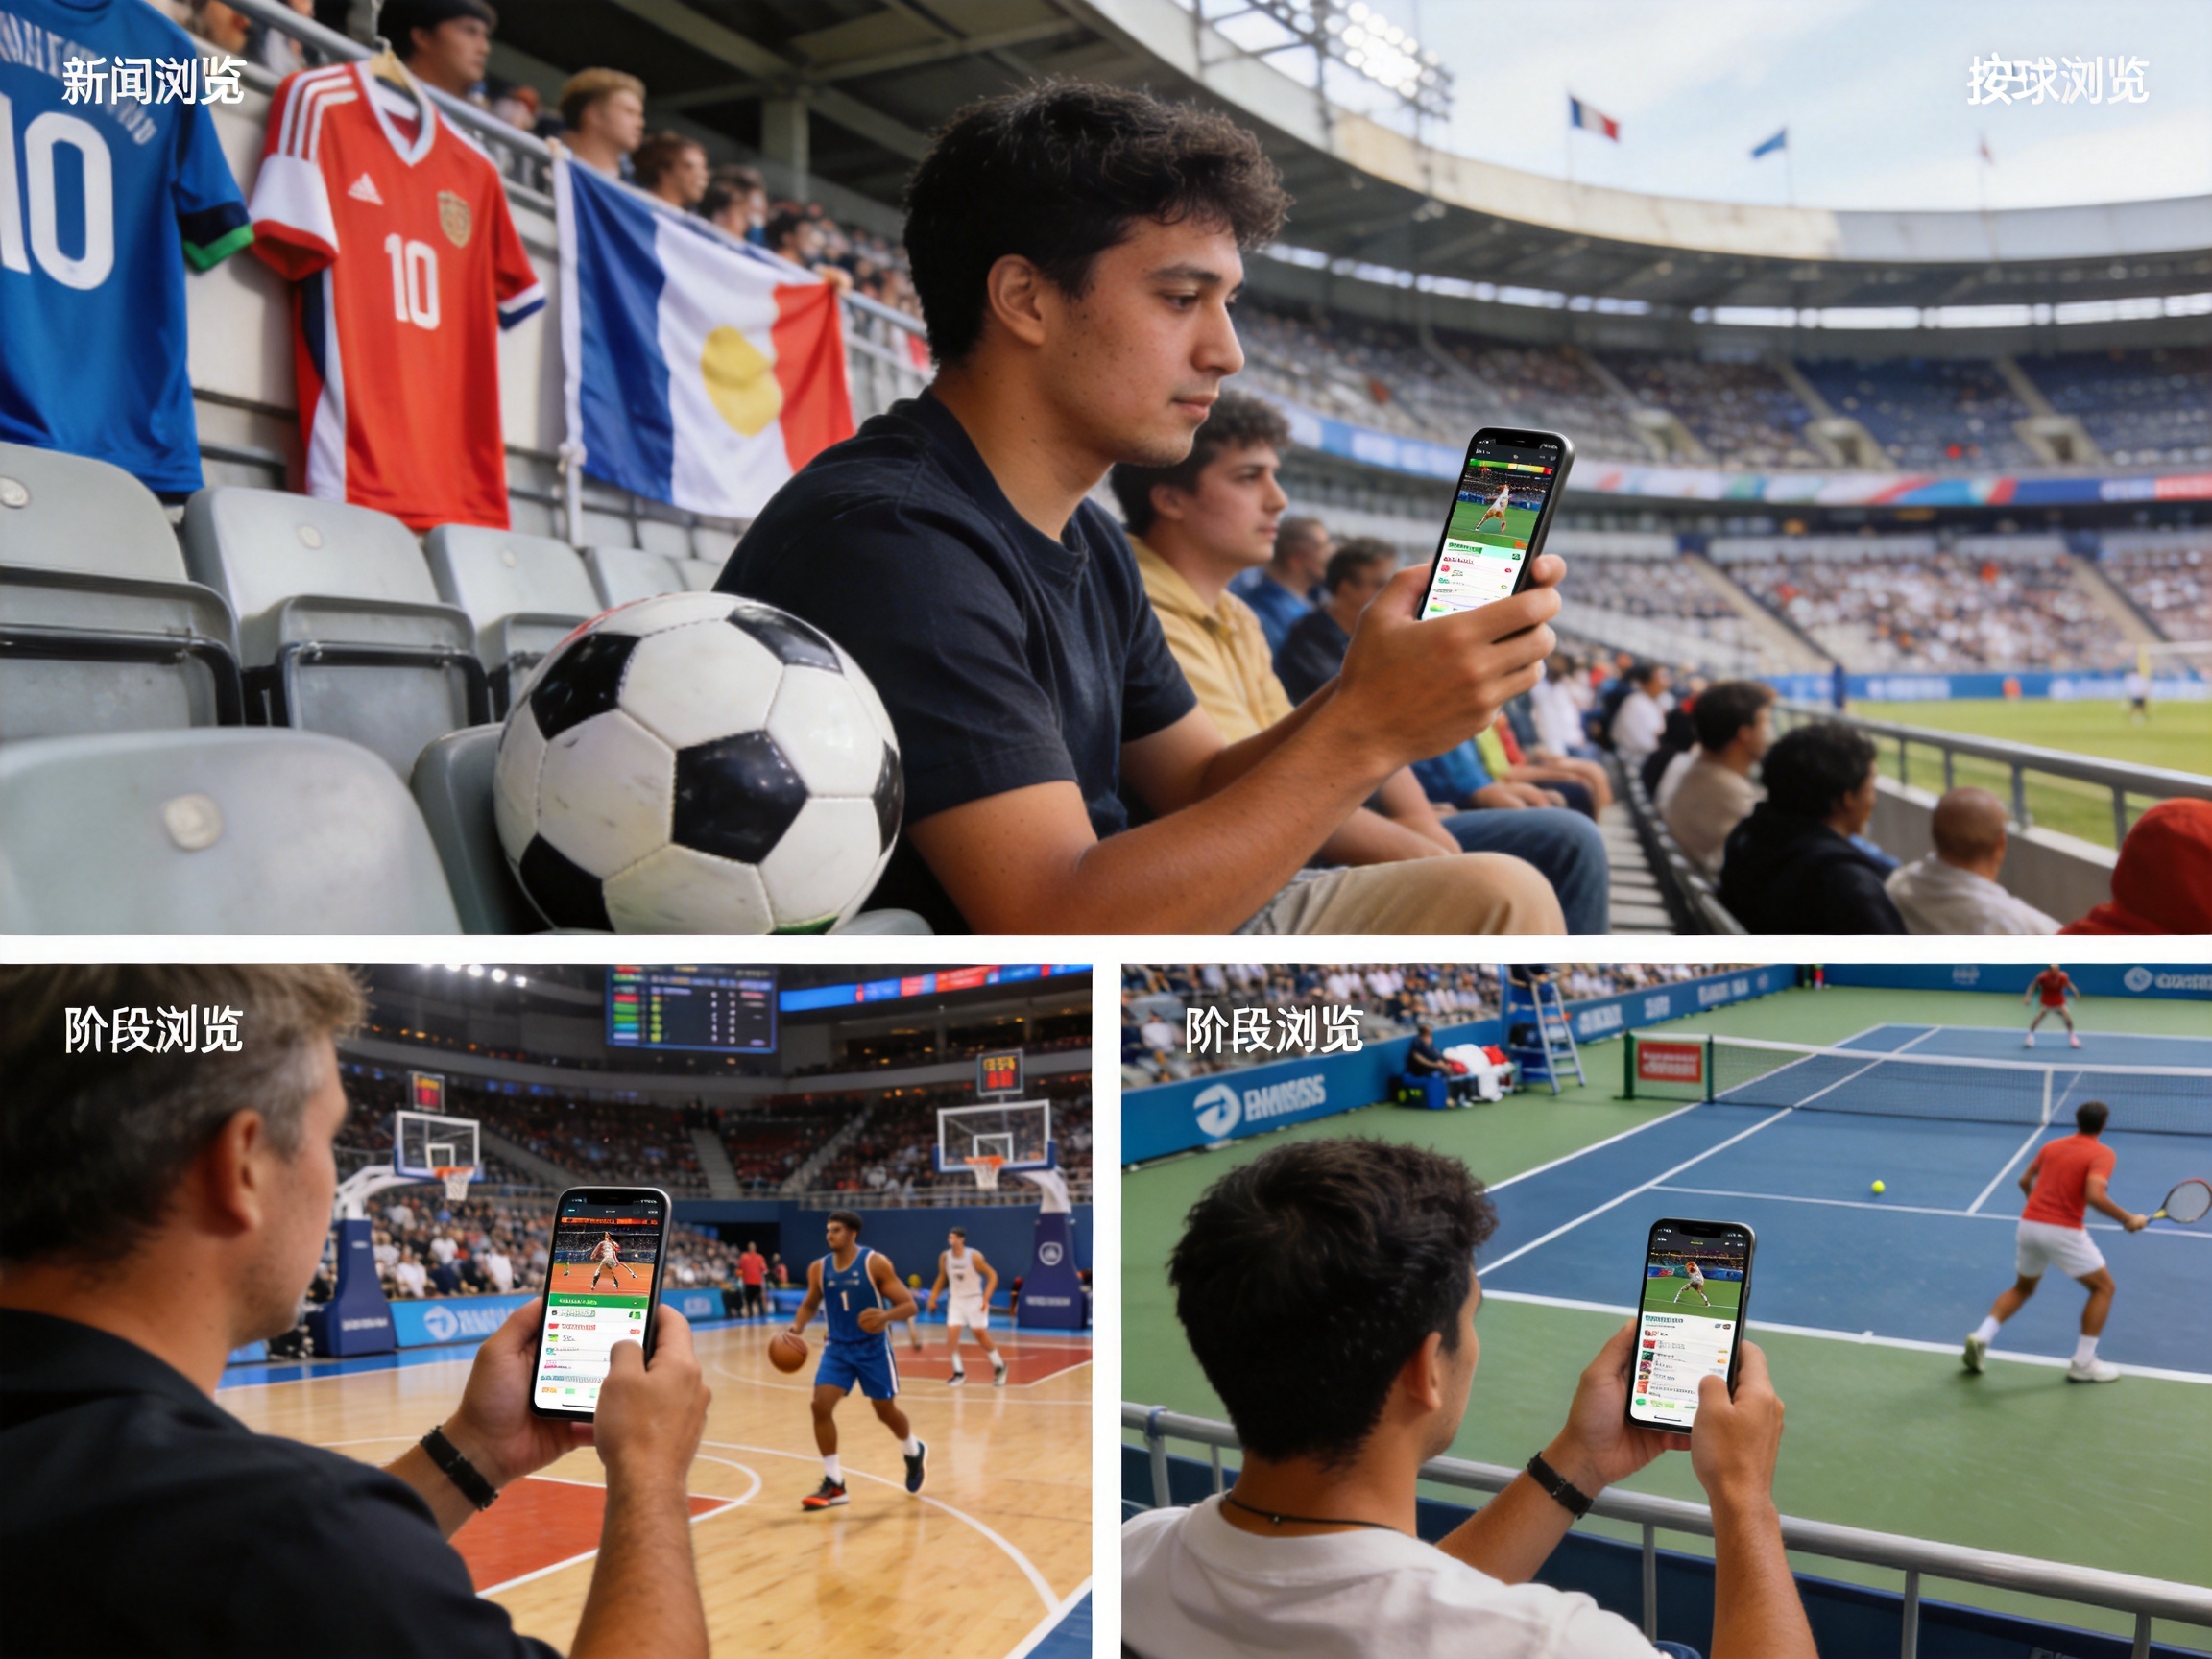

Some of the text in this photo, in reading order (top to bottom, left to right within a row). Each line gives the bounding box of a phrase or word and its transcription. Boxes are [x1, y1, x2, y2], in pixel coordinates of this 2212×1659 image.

[0, 91, 114, 290] 10
[385, 232, 440, 330] 10
[840, 1290, 850, 1311] 1
